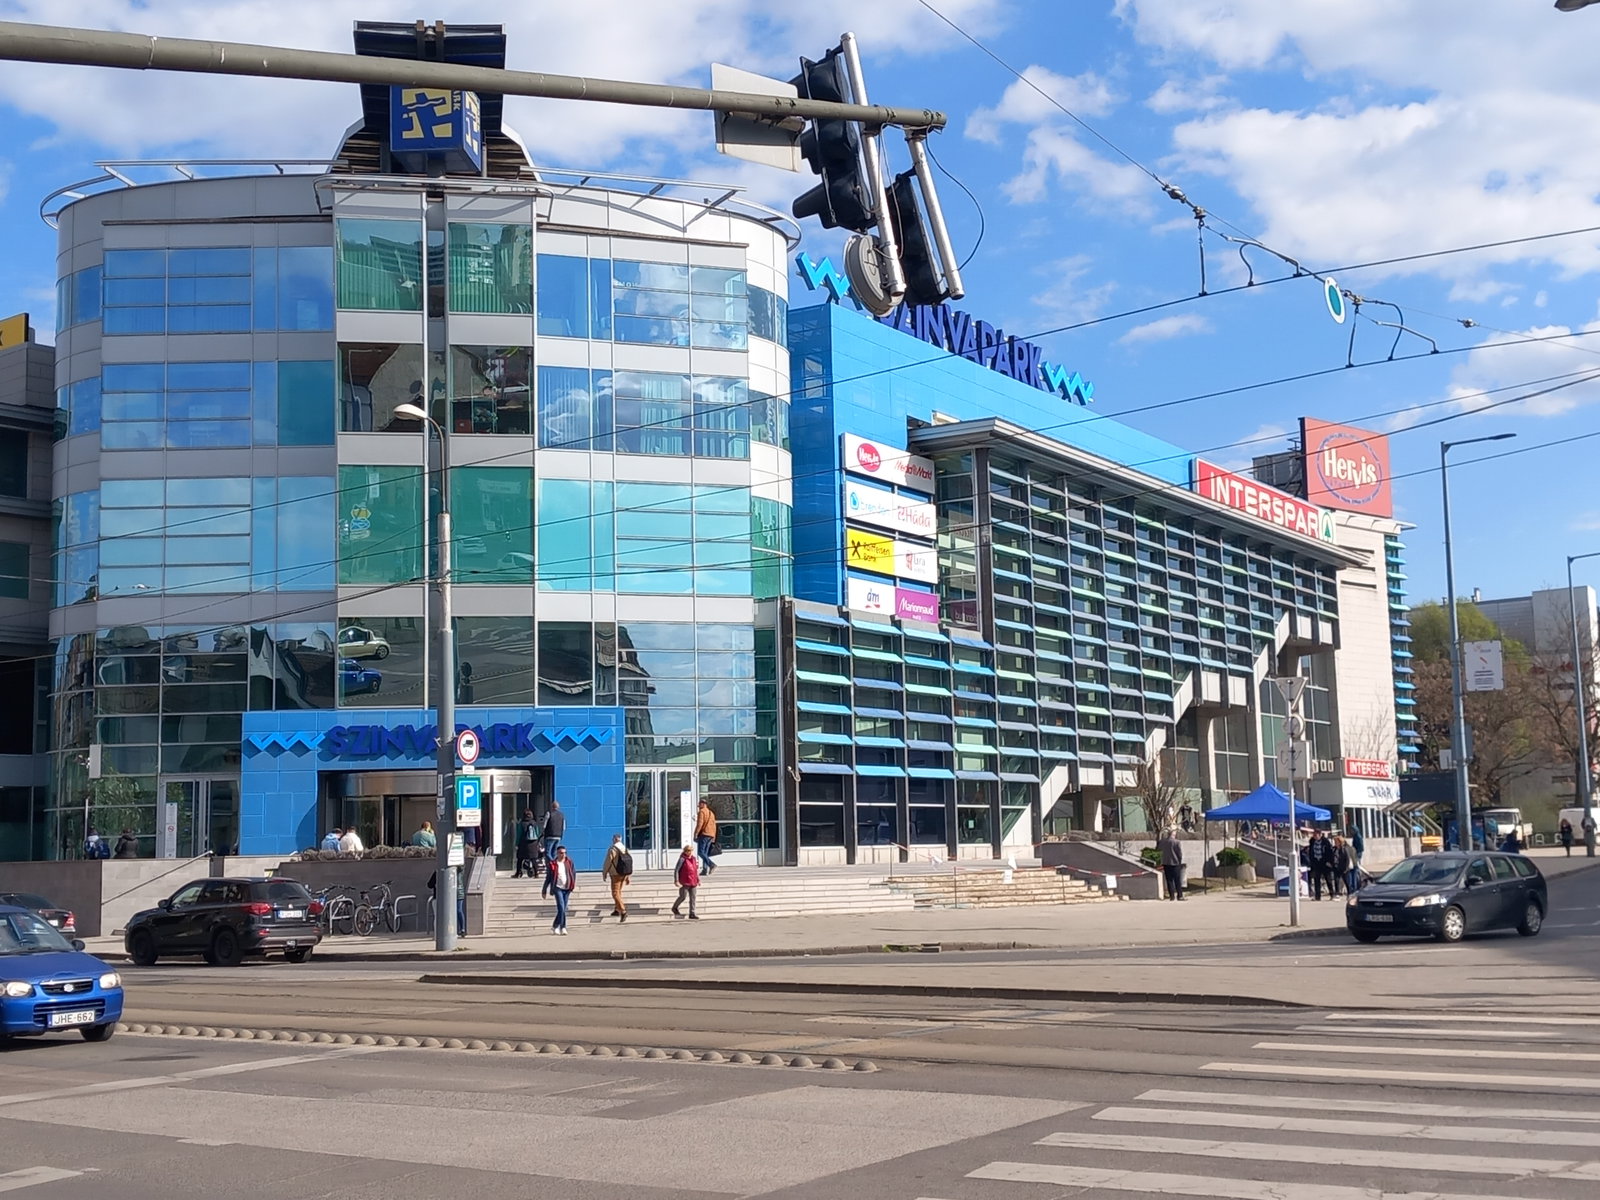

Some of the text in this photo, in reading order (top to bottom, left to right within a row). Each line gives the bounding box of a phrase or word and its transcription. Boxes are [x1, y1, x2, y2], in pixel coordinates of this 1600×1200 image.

[879, 302, 1044, 391] ZINVAPARK
[1323, 446, 1378, 489] Hervis
[1210, 471, 1319, 539] INTERSPAR
[867, 588, 880, 602] dm
[898, 597, 934, 616] Marionnaud
[1349, 761, 1390, 776] INTERSPAR
[463, 784, 475, 806] P
[54, 1012, 93, 1024] JHE-662
